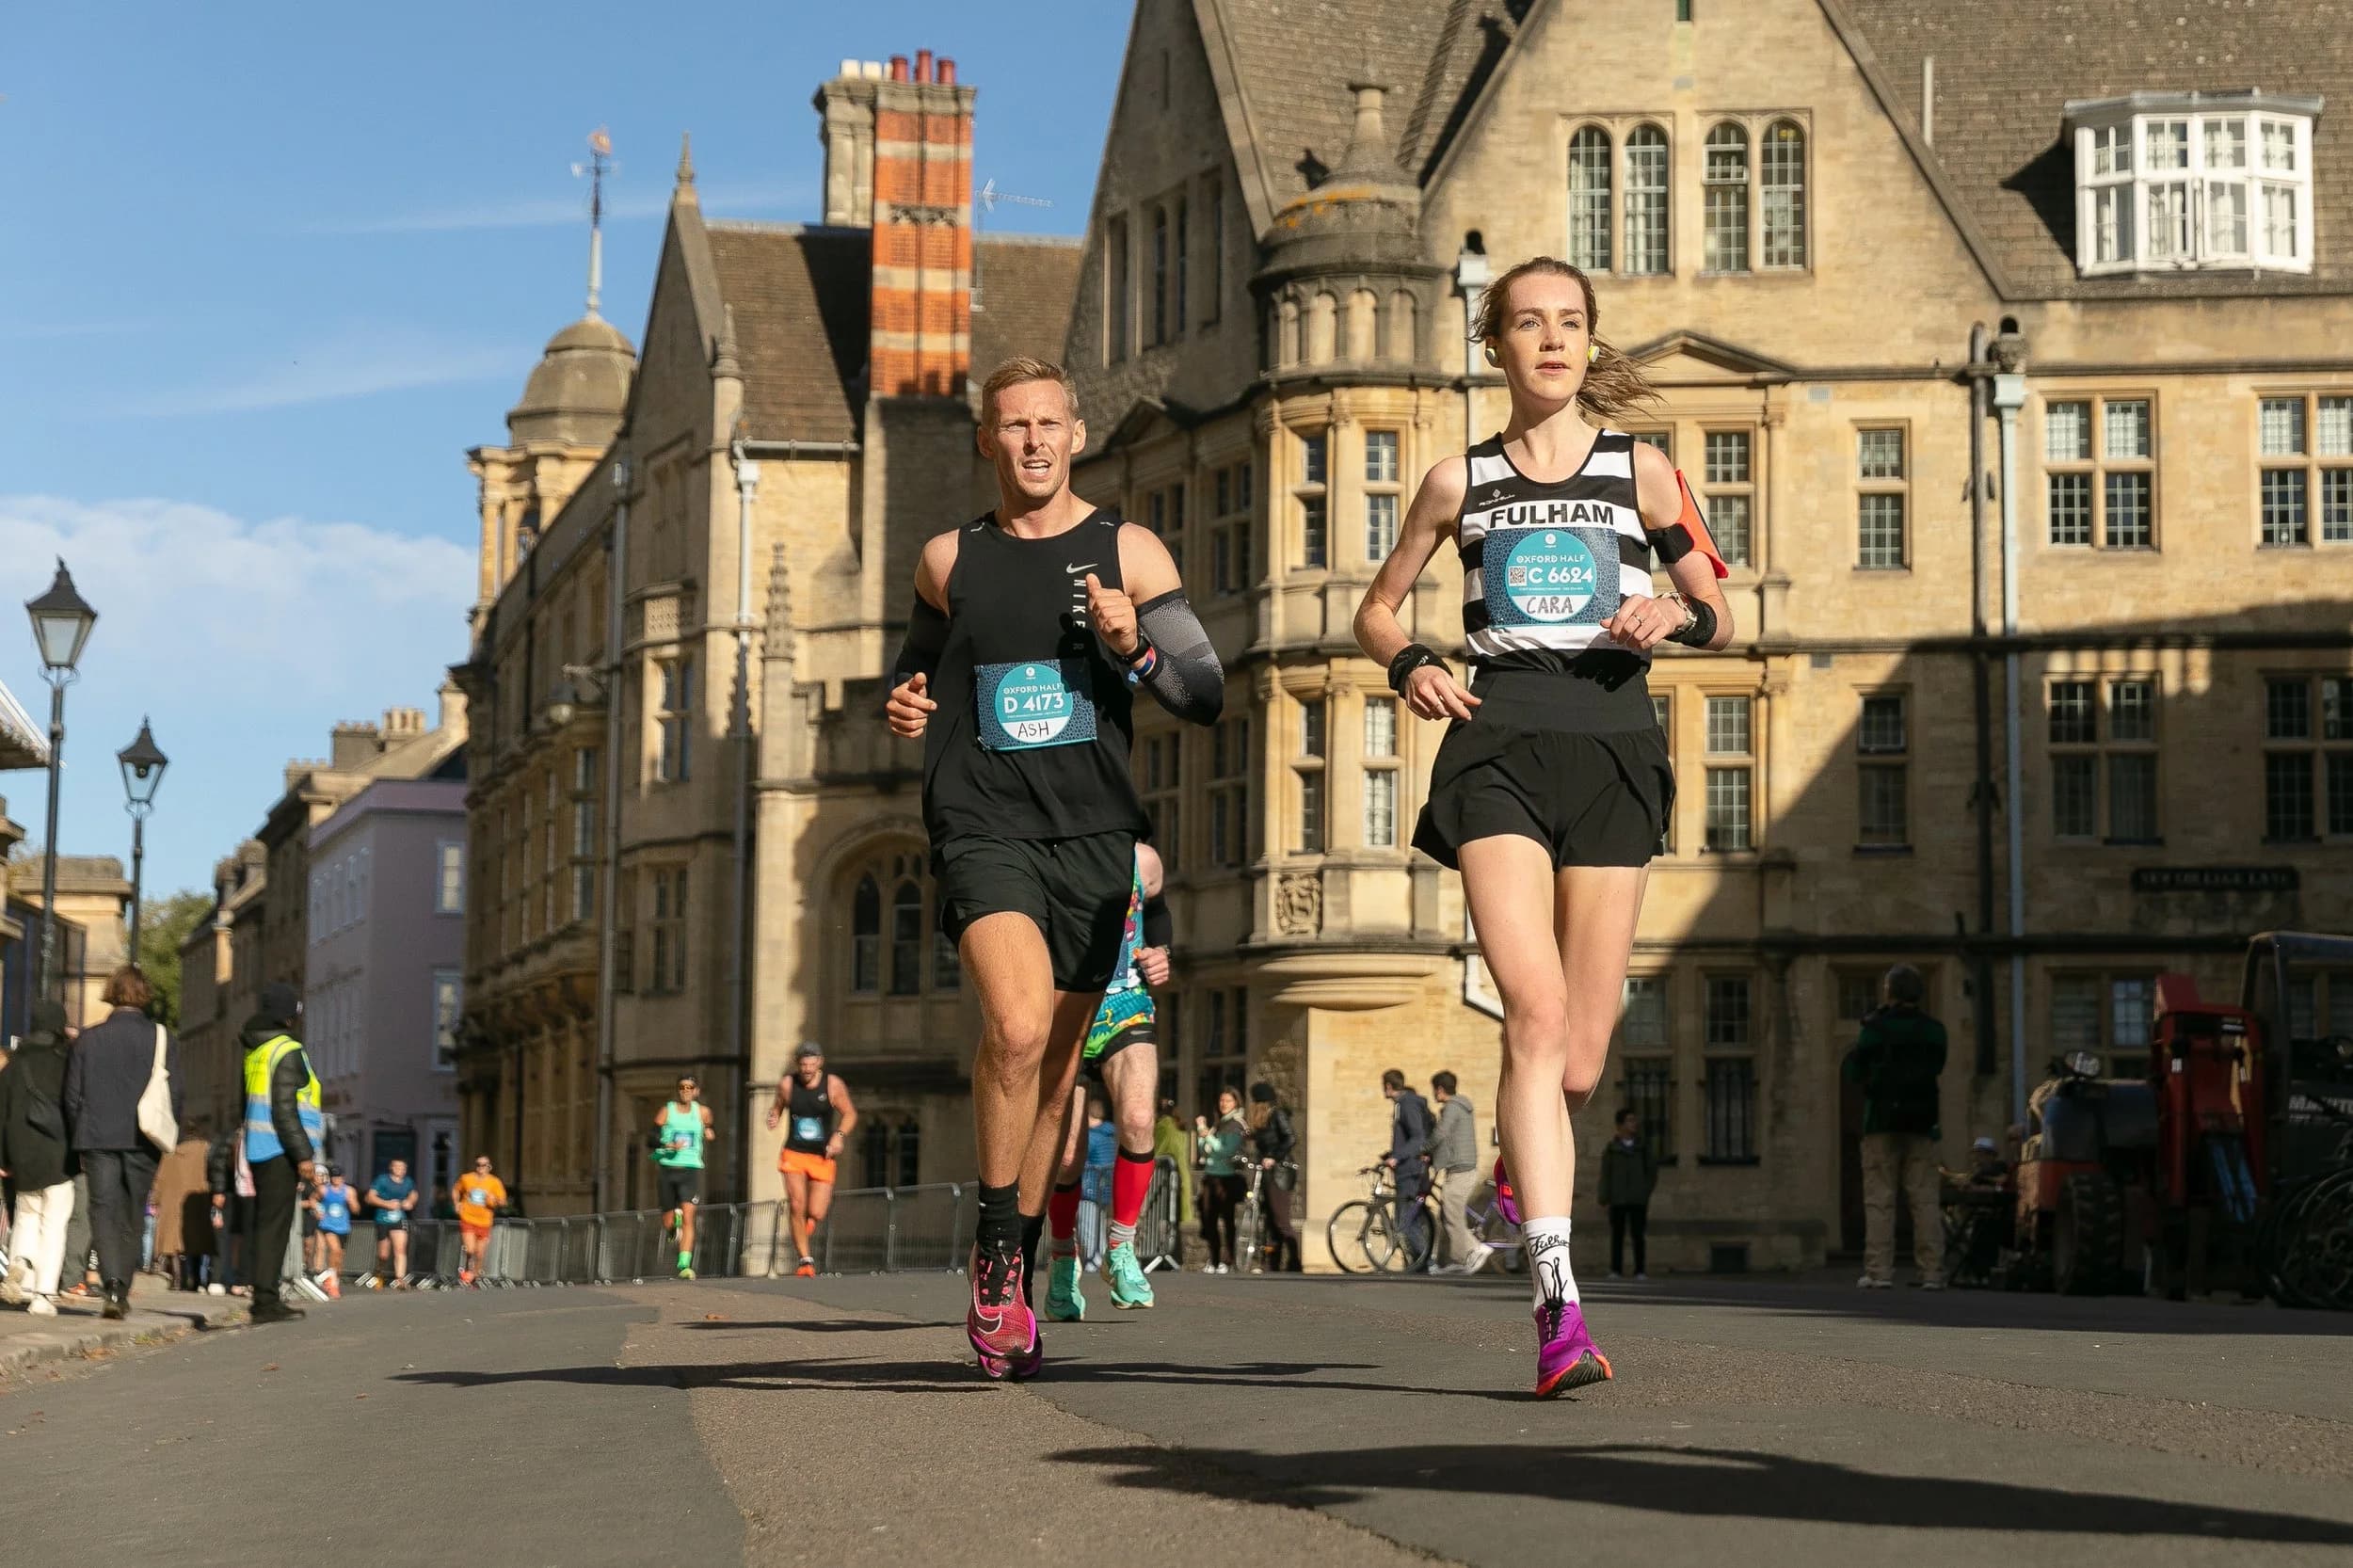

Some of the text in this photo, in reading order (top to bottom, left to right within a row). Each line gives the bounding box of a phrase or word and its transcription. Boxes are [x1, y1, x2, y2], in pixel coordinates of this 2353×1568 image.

[1490, 503, 1614, 529] FULHAM
[1516, 553, 1586, 564] OXFORD HALF
[1528, 567, 1593, 584] C 6624
[1072, 579, 1087, 630] NIKE
[1527, 596, 1574, 615] CARA
[1003, 682, 1064, 695] OXFORD HALF
[1003, 692, 1064, 713] D 4173
[1017, 721, 1049, 739] ASH
[1527, 1233, 1571, 1257] Fulha
